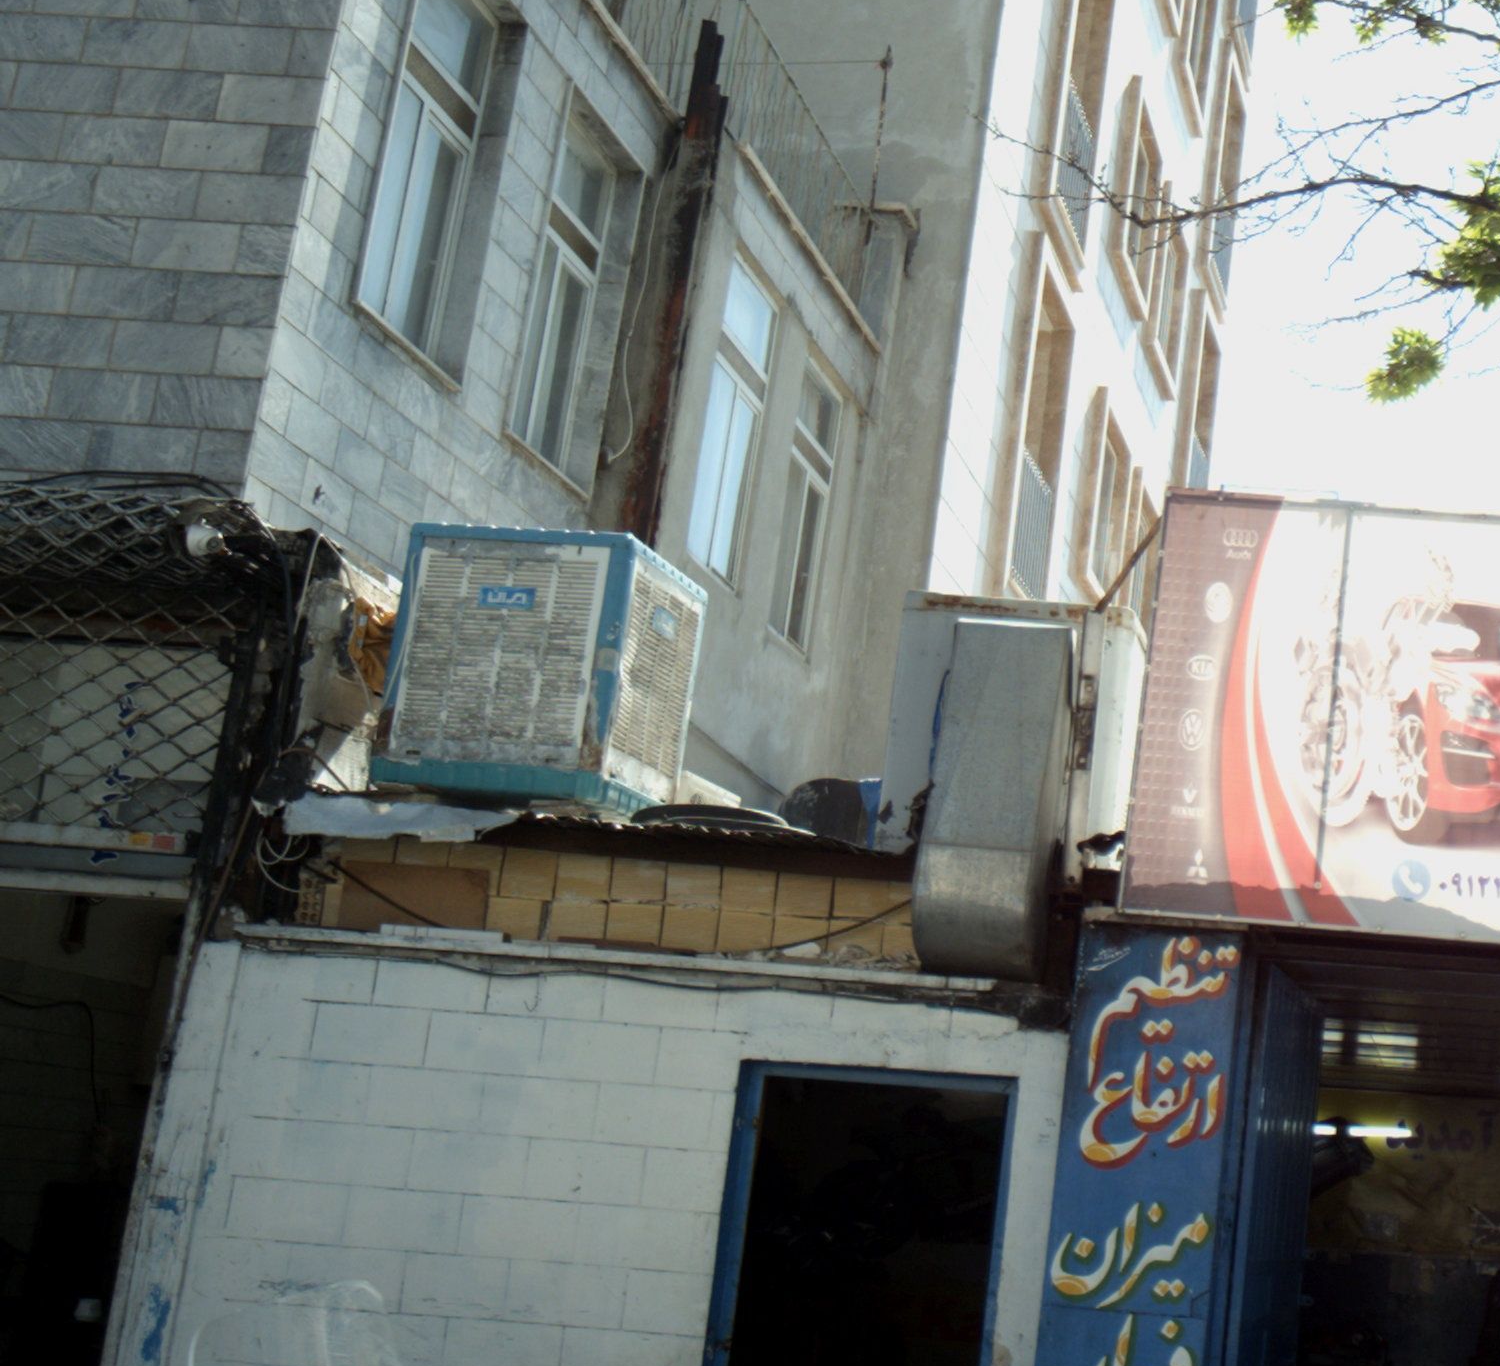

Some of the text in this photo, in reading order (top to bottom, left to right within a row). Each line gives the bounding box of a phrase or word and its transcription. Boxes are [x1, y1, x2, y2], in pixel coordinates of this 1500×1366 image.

[1087, 937, 1240, 1093] تنظیم
[1079, 1049, 1227, 1167] ارتفاع
[1050, 1202, 1209, 1310] میزان
